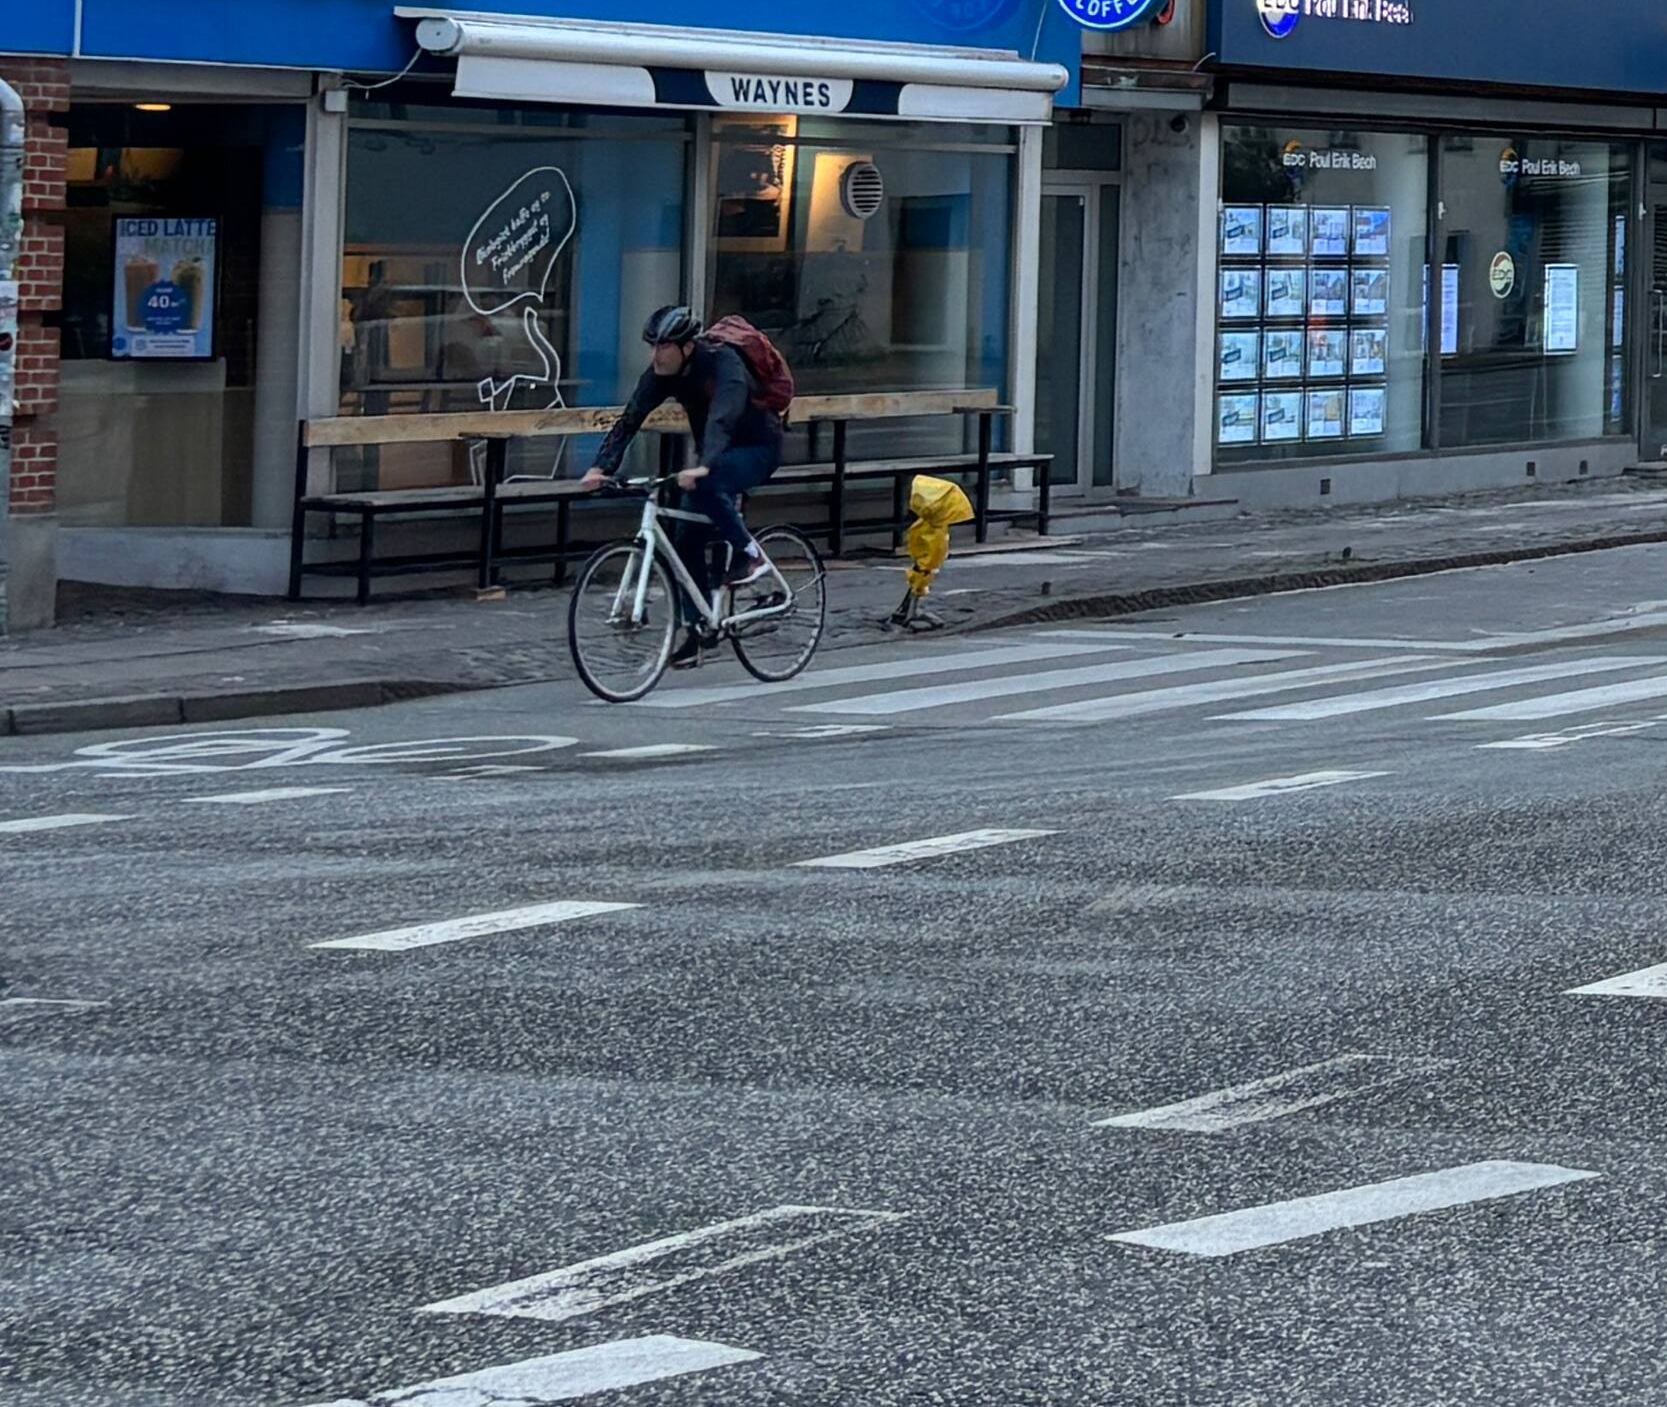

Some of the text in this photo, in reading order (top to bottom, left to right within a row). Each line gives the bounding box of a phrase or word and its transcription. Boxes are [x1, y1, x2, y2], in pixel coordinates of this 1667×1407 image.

[731, 76, 830, 107] WAYNES
[121, 219, 216, 236] ICED LATTE
[147, 295, 171, 309] 40
